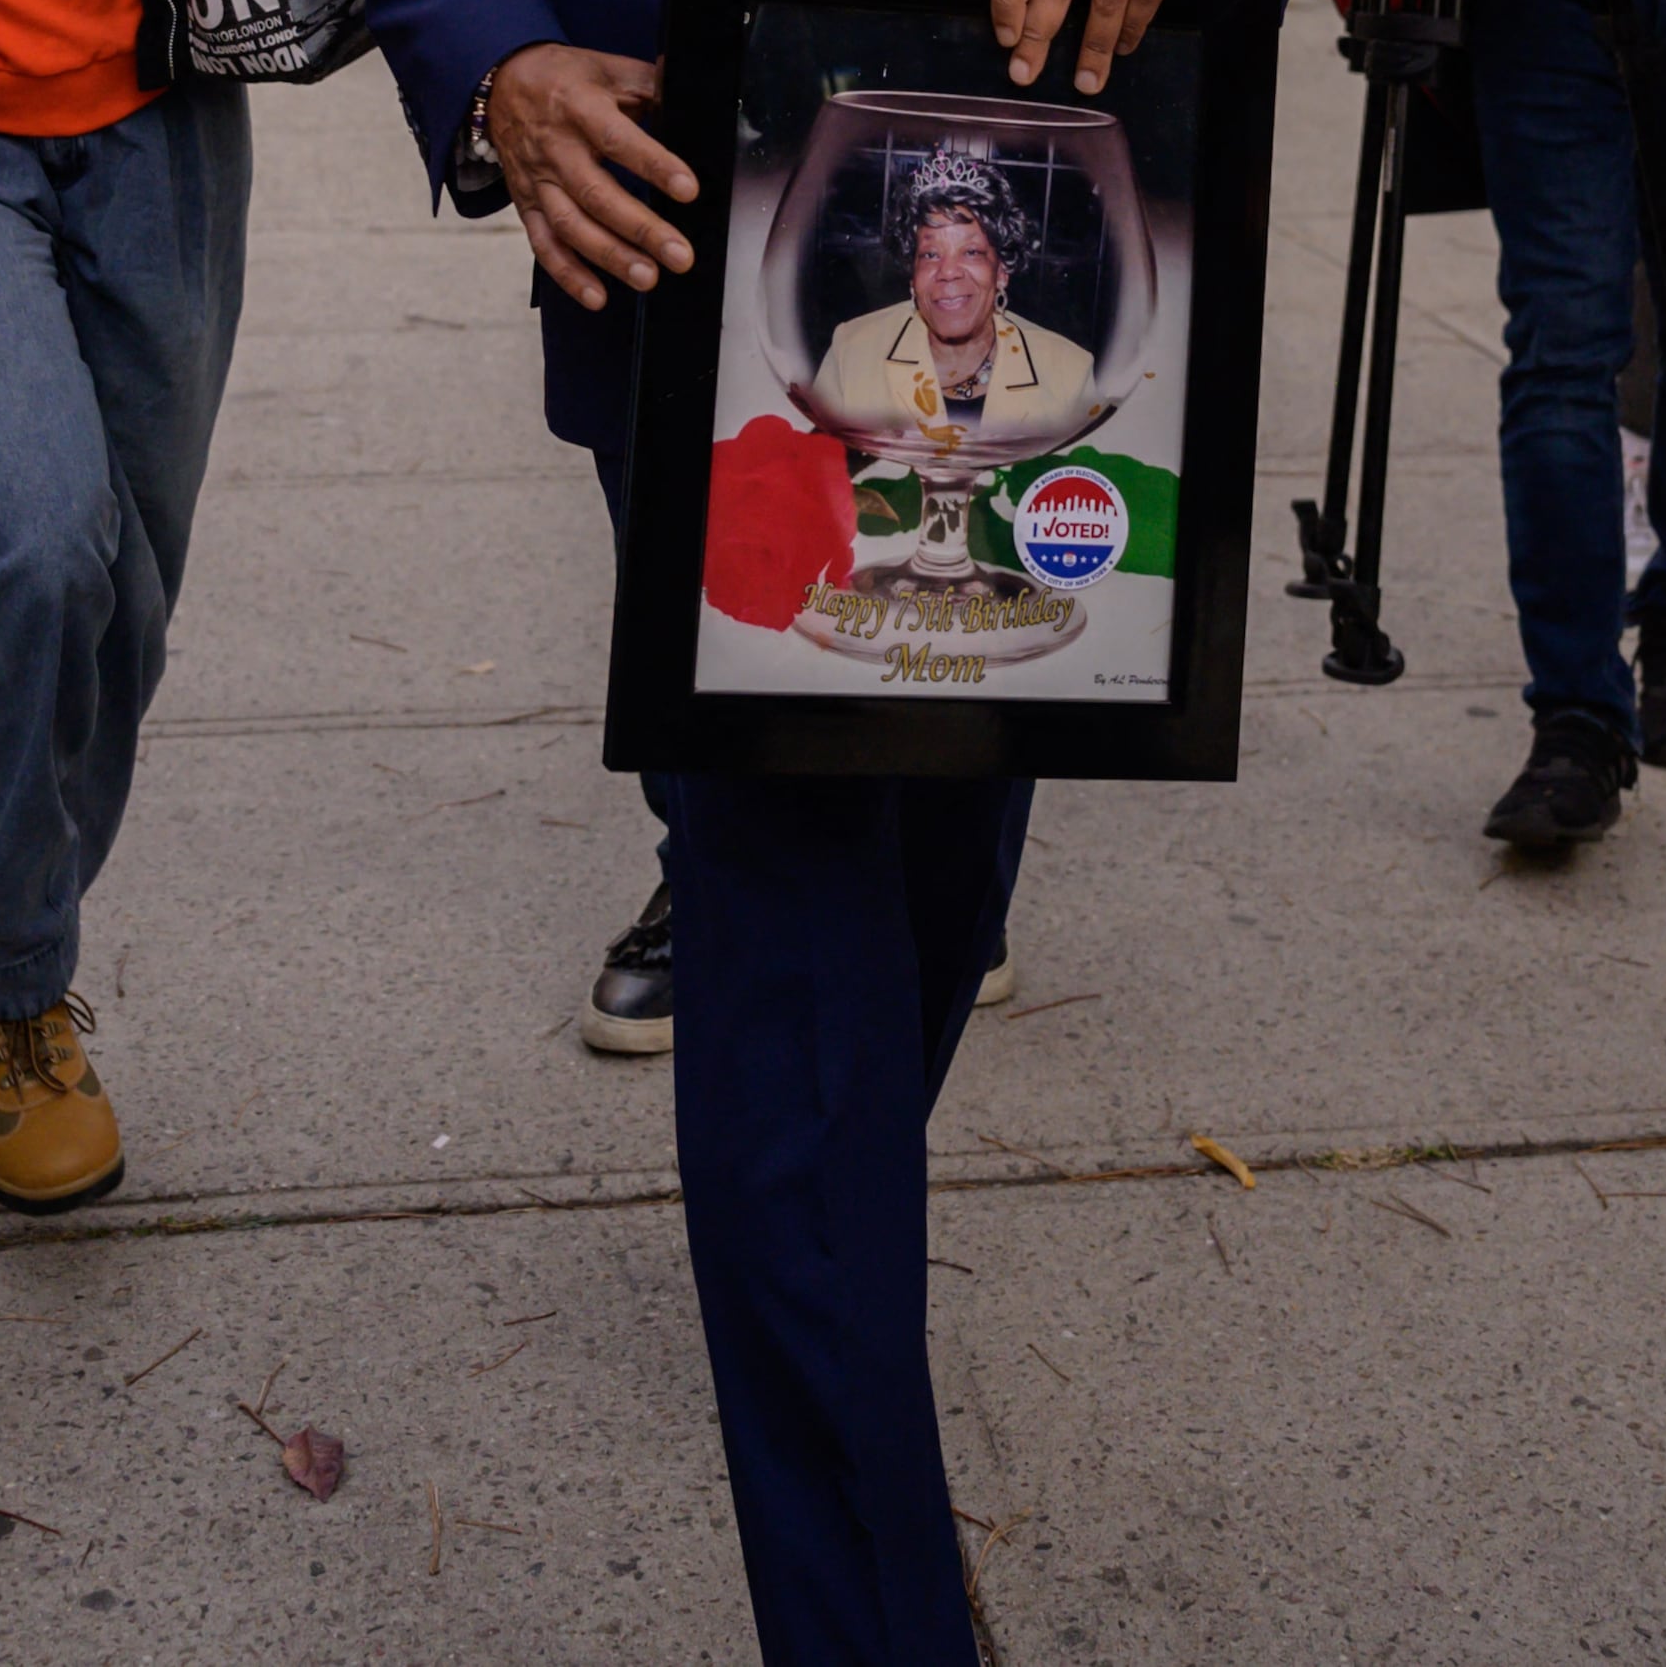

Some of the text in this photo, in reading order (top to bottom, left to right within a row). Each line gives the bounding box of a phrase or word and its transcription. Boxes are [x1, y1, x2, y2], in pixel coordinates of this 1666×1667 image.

[1033, 516, 1110, 540] I VOTED!
[802, 583, 1075, 639] Happy 75th Birthday
[881, 642, 986, 683] Mom
